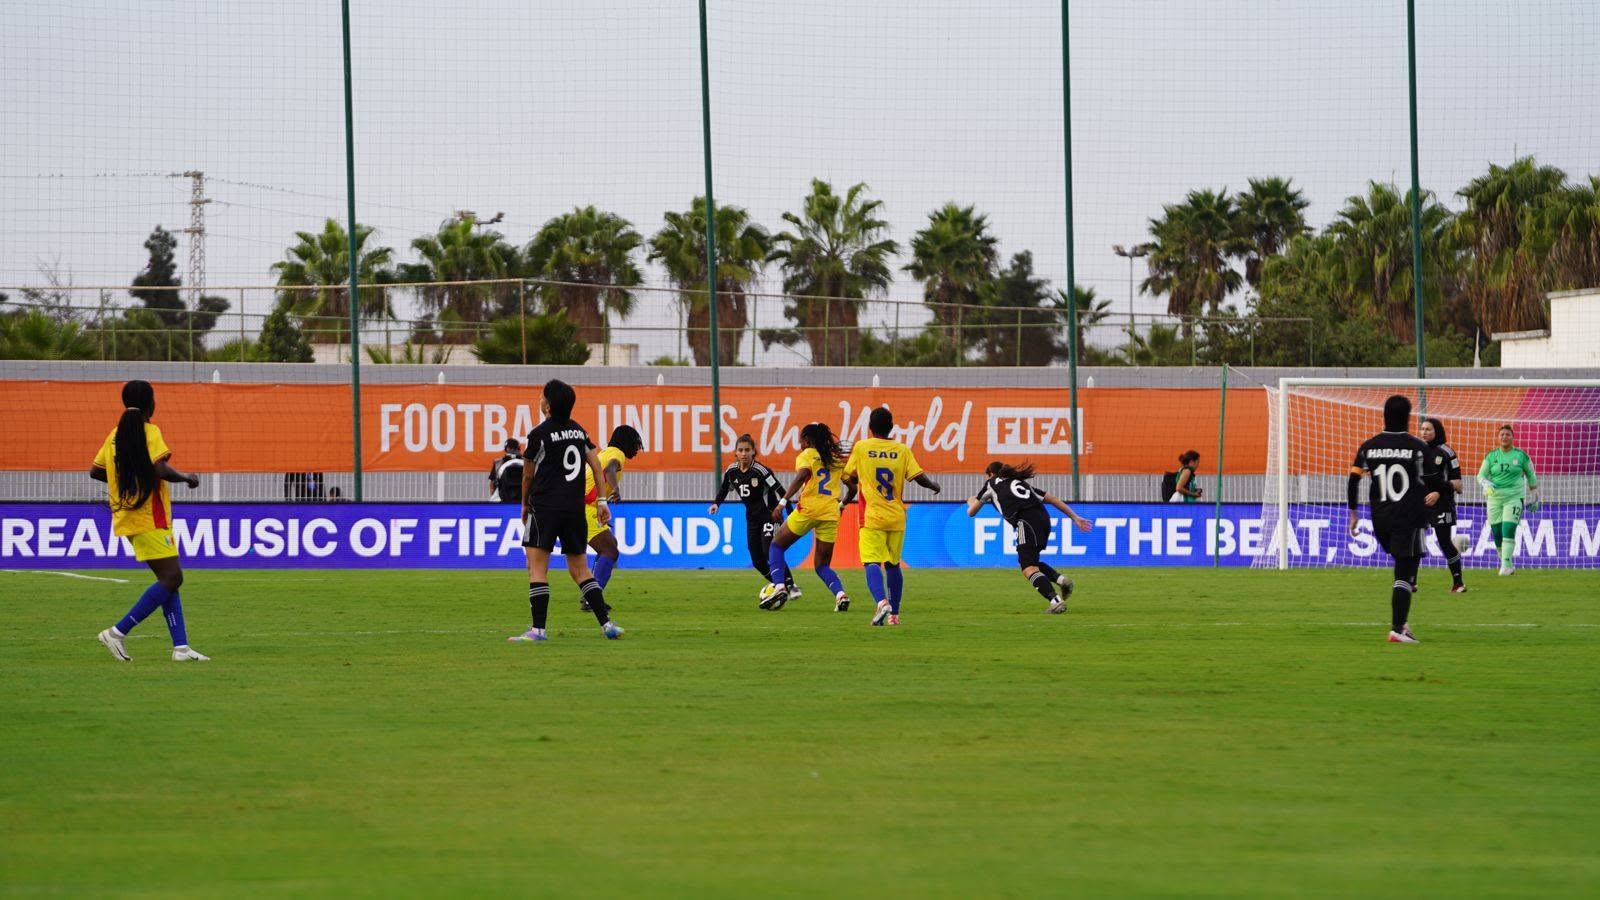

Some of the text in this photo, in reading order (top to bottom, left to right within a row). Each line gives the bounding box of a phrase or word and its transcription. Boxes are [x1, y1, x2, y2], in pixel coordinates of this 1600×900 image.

[380, 403, 547, 454] FOOTBA
[598, 404, 738, 454] UNITES
[751, 396, 803, 456] th
[997, 417, 1073, 445] FIFA
[563, 444, 582, 482] 9
[868, 450, 898, 459] SAO
[1367, 448, 1413, 459] HAIDARI
[816, 468, 832, 496] 2
[1500, 463, 1511, 473] 12
[739, 484, 751, 497] 15
[1010, 479, 1031, 499] 6
[1374, 463, 1410, 502] 10
[172, 517, 338, 558] MUSIC
[349, 517, 419, 558] OF
[428, 517, 527, 556] FIFA
[1095, 517, 1193, 556] THE
[1206, 518, 1338, 563] BEAT,
